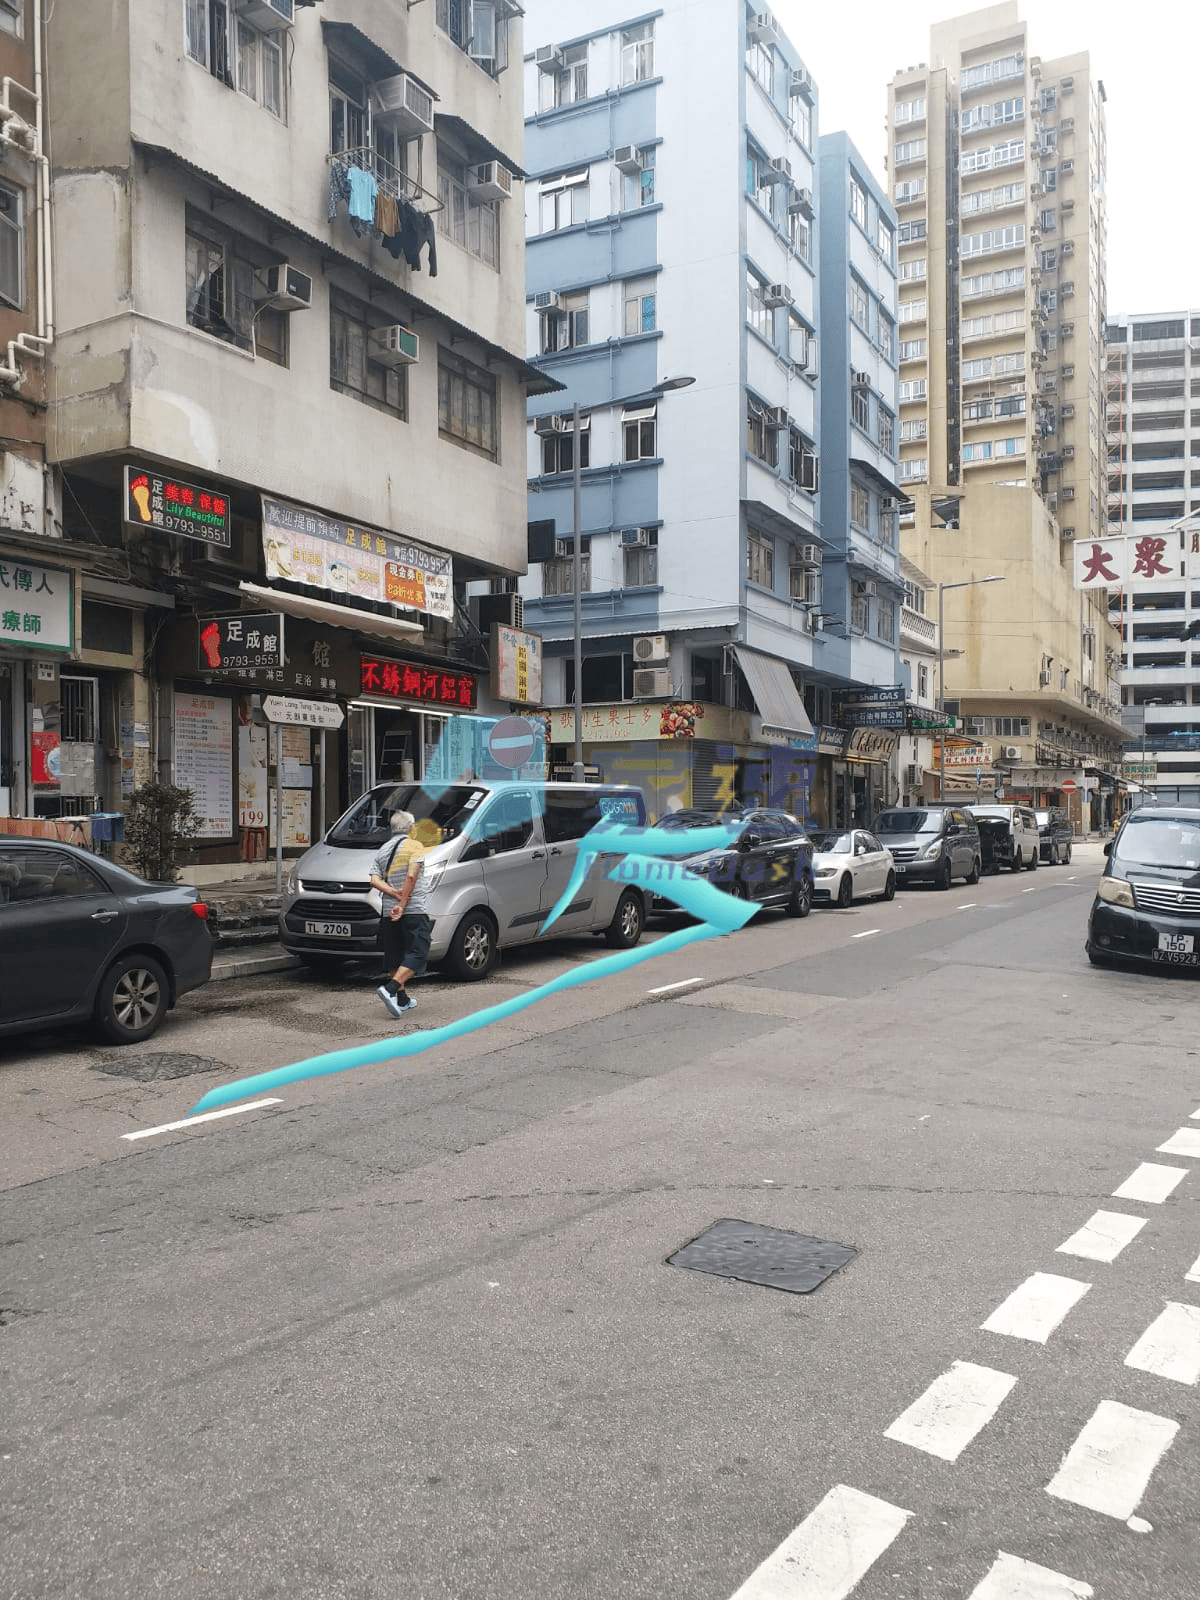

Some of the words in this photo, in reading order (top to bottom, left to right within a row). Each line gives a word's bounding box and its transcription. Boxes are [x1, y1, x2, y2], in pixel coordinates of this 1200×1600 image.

[152, 480, 164, 526] 足成館
[166, 500, 183, 517] Lily
[185, 506, 225, 527] Beautiful
[165, 516, 227, 542] 9793-9551
[1081, 536, 1174, 583] 大眾
[2, 610, 42, 635] 療師
[227, 620, 278, 653] 足成館
[223, 654, 280, 667] 9793-9551
[879, 692, 899, 700] GAS
[270, 698, 284, 706] Yuen
[285, 700, 298, 710] Long
[299, 702, 312, 711] Tung
[323, 705, 339, 713] Street
[241, 811, 264, 825] 199
[307, 922, 320, 934] TL
[323, 923, 349, 935] 2706
[1167, 941, 1186, 951] 150
[1169, 934, 1185, 943] TP
